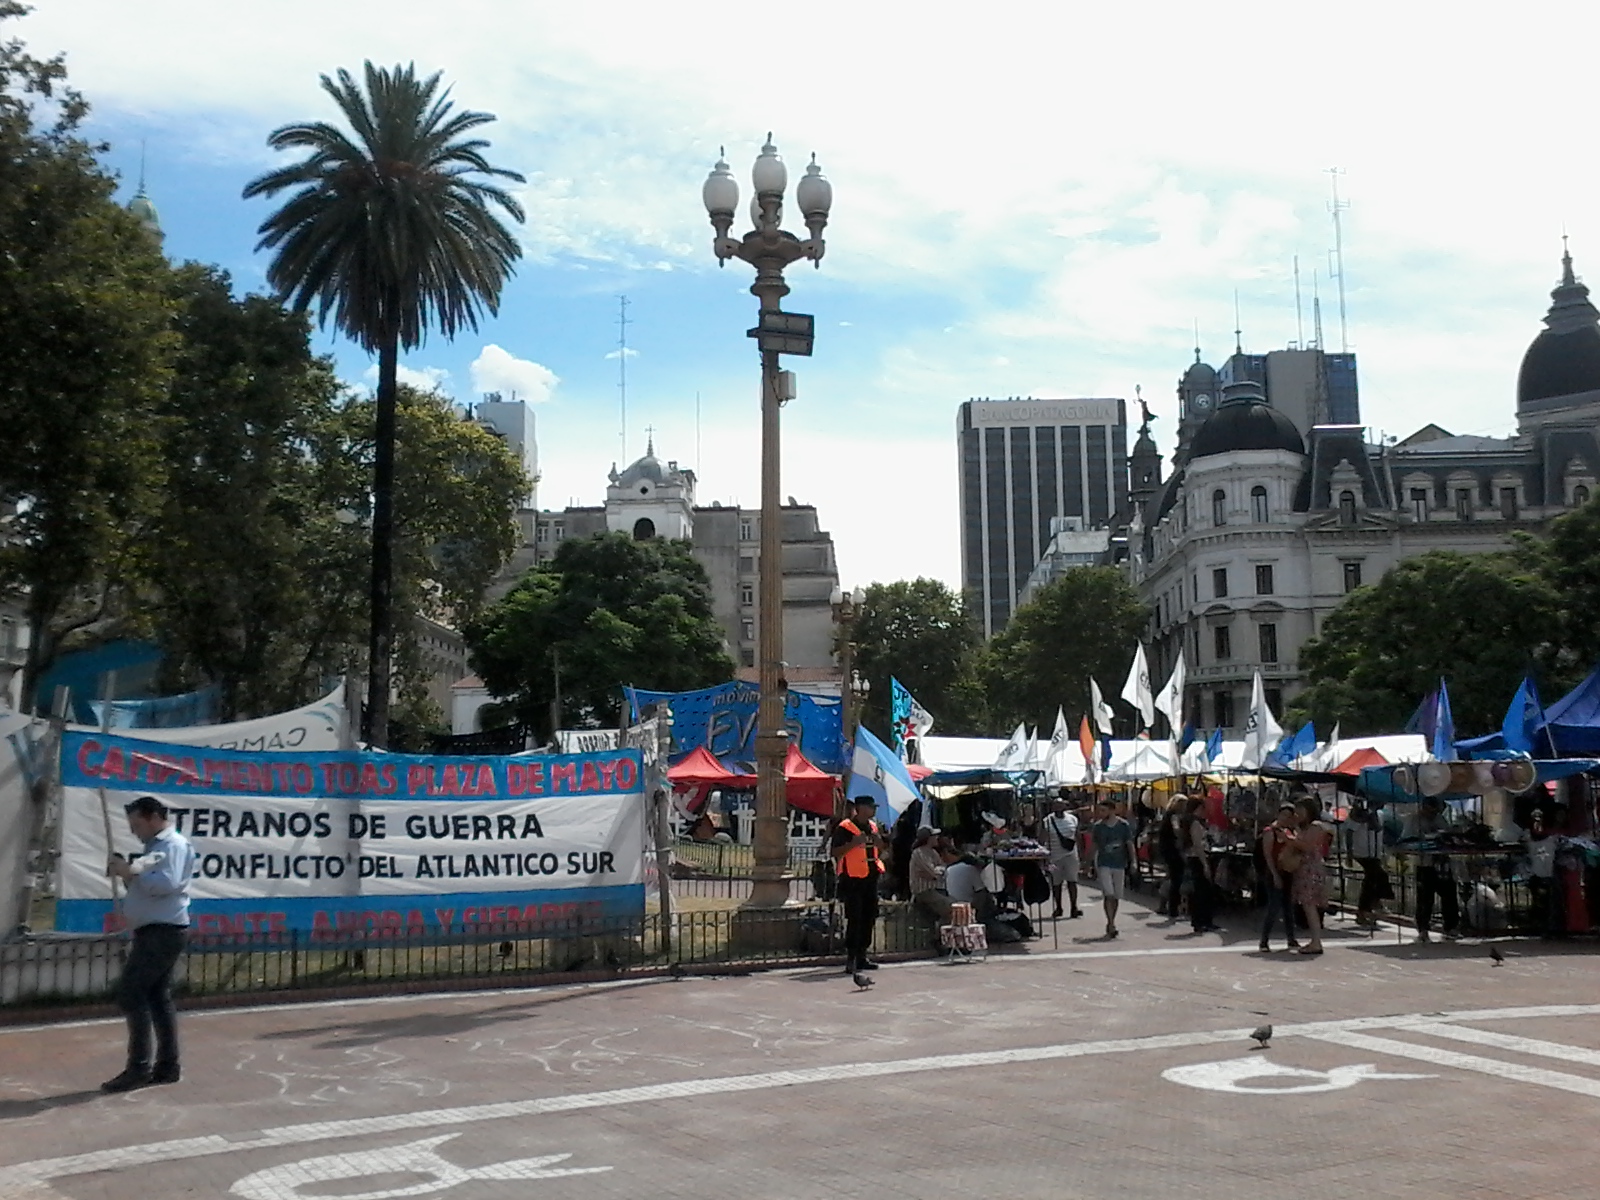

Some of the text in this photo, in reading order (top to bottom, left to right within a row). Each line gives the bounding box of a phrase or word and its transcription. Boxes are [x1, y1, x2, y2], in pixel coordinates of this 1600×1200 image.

[77, 739, 637, 796] CAMPAMENTO TOAS PLAZA DE MAYO
[169, 807, 544, 840] TERANOS DE GUERRA
[358, 855, 404, 878] DEL
[415, 852, 559, 878] ATLANTICO
[566, 851, 616, 875] SUR
[310, 908, 428, 943] AHORA
[434, 907, 454, 935] Y
